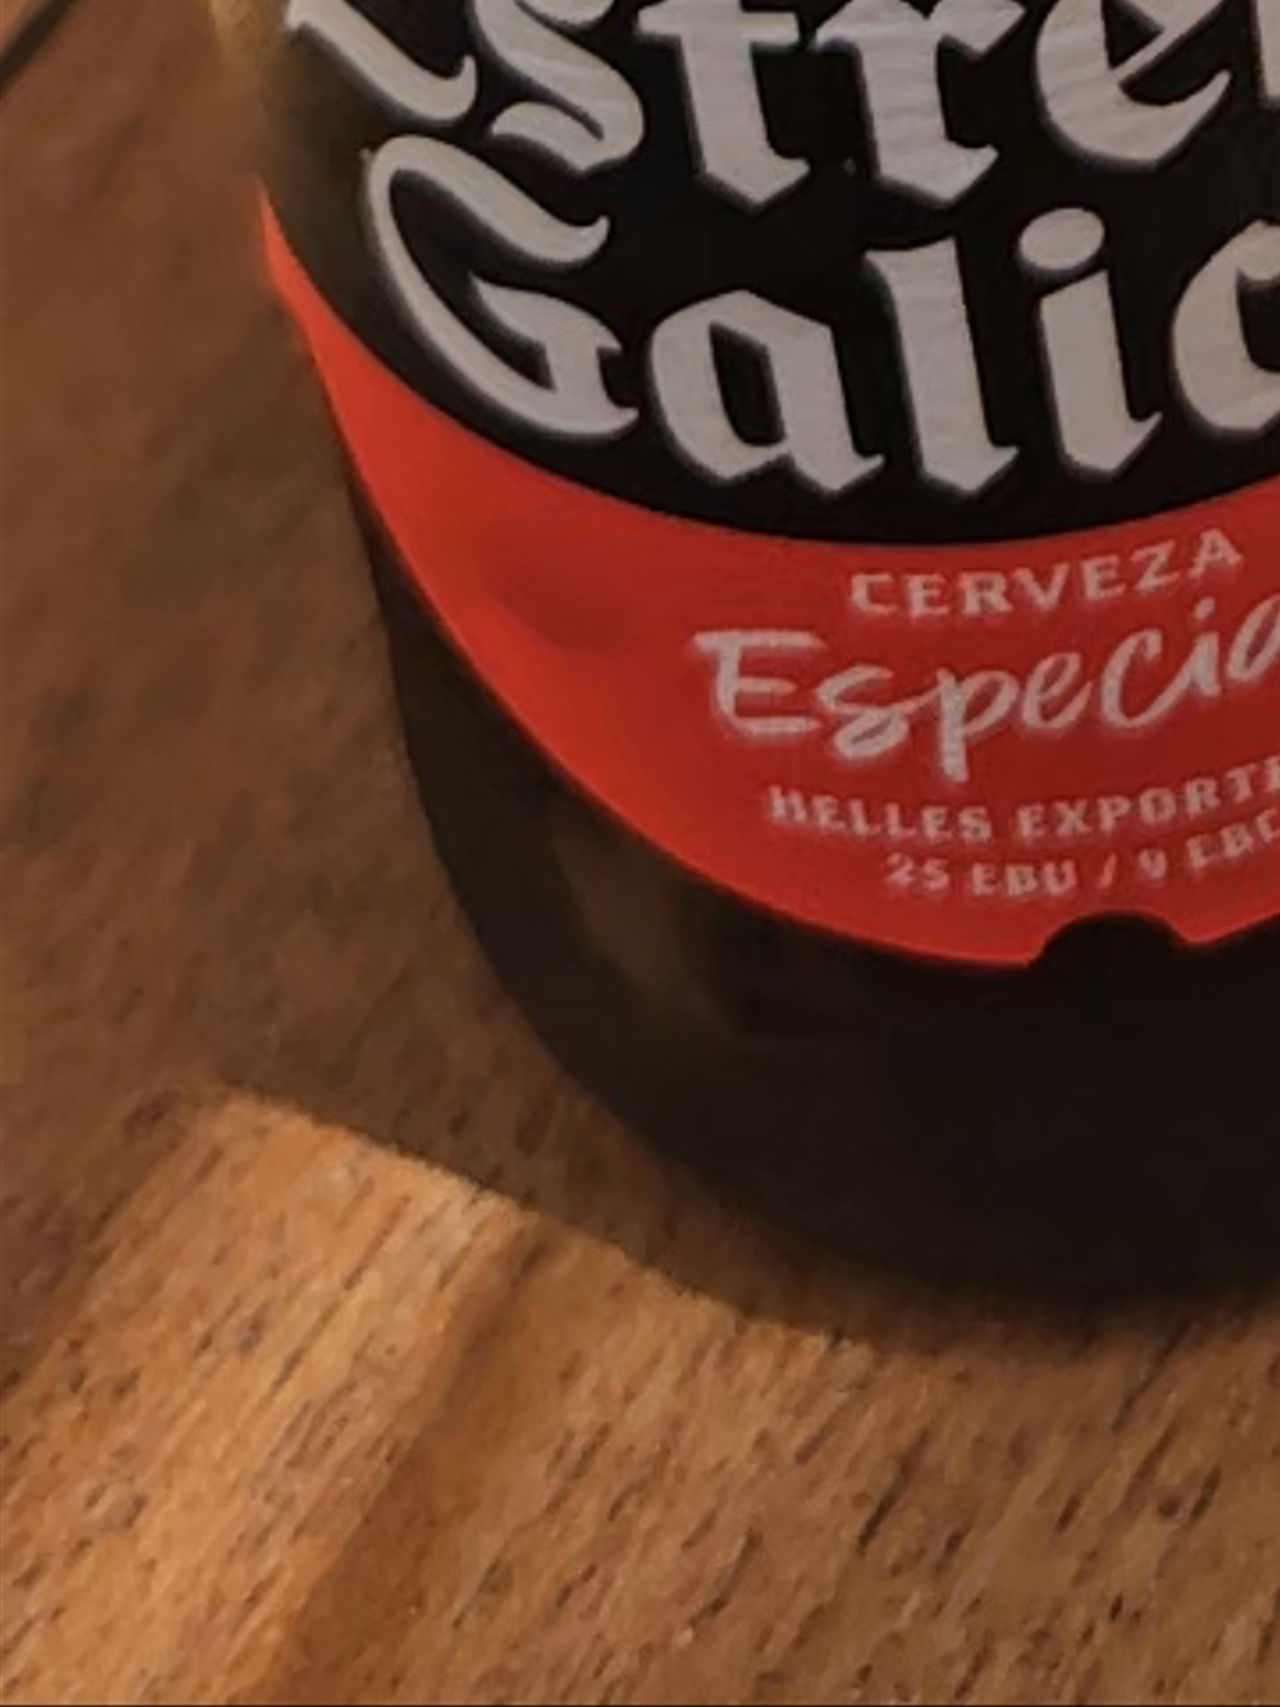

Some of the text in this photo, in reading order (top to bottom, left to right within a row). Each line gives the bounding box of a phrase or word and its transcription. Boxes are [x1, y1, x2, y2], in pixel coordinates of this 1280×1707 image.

[848, 526, 1245, 618] CERVEZA
[768, 783, 994, 843] HELLES
[884, 852, 949, 892] 25
[970, 860, 1080, 898] EBU
[1136, 846, 1169, 882] 9
